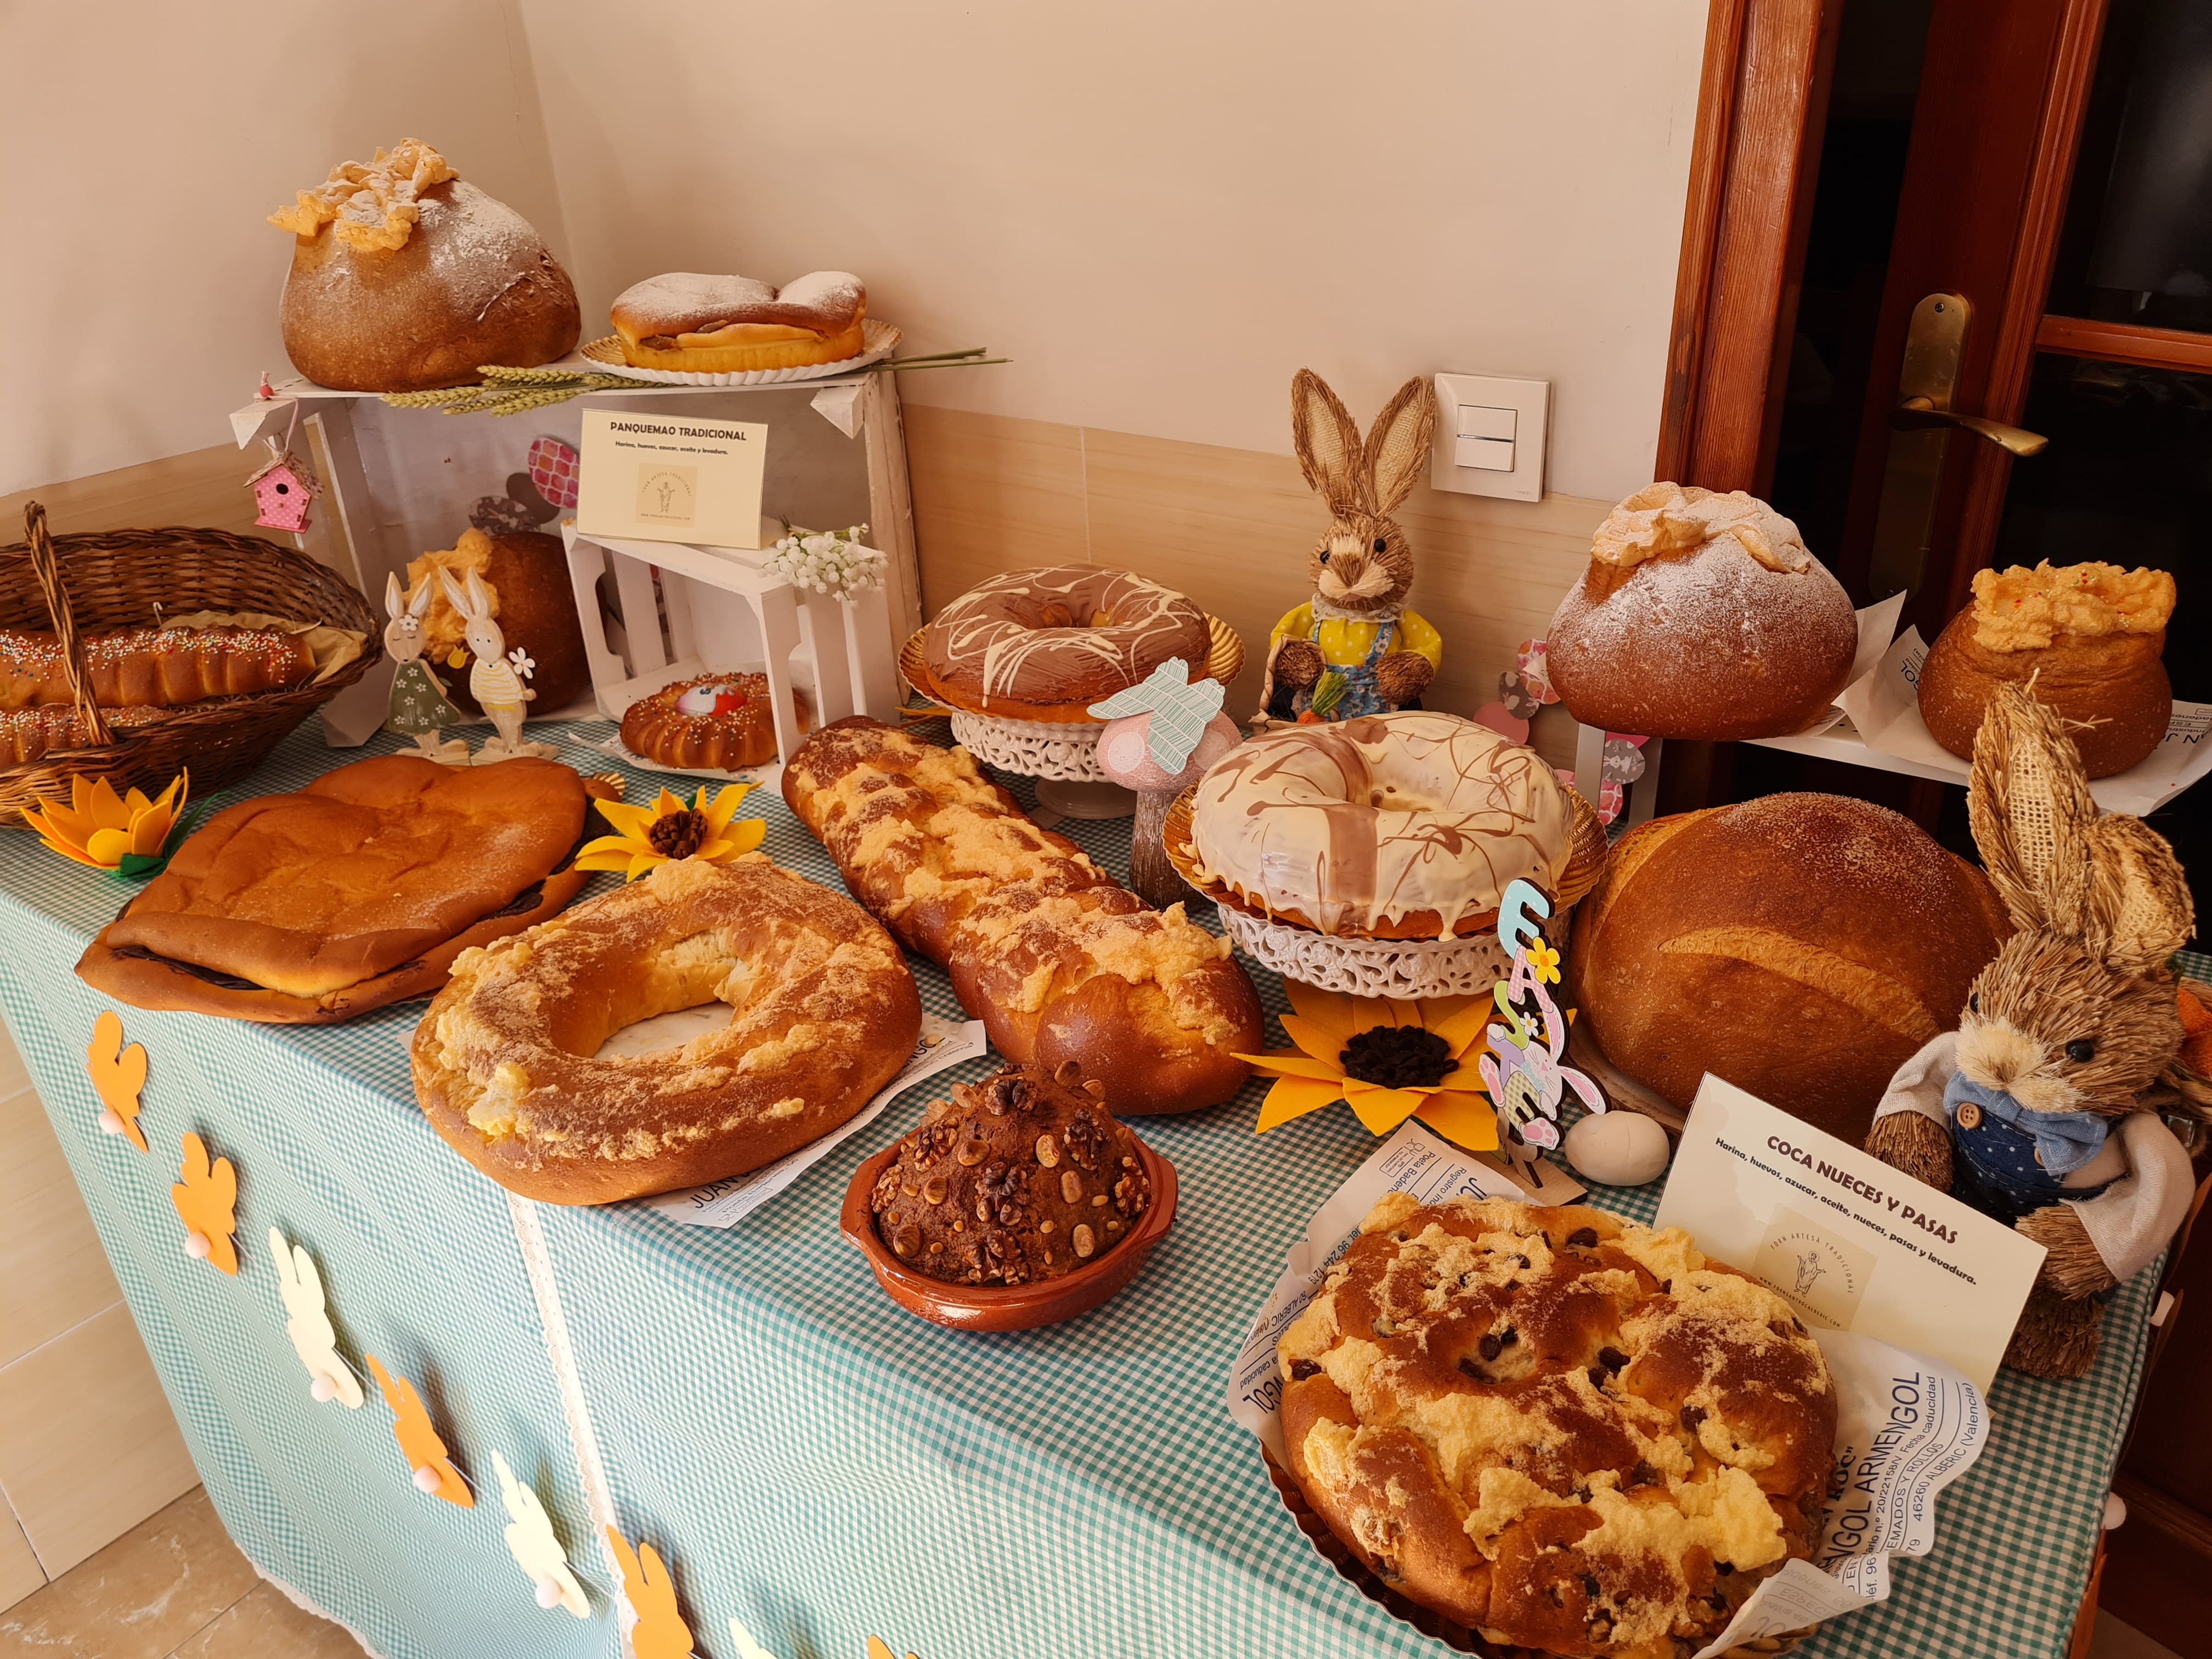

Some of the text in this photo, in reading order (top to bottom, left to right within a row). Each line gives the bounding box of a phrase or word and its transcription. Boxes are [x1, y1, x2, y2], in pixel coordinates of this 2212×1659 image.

[610, 422, 747, 441] PANQUEMAO TRADICIONAL
[1413, 1151, 1436, 1168] Poeta
[1440, 1167, 1467, 1194] Registro
[1767, 1136, 1958, 1244] COCA NUECES Y PASAS
[1716, 1137, 1977, 1285] Harina, huevos, azucar, aceite, nueces, pasas y levadura.
[1337, 1240, 1350, 1254] 96
[1770, 1236, 1787, 1250] FORN
[1825, 1242, 1854, 1294] TRADICIONAL
[1240, 1361, 1270, 1390] caducidad
[1854, 1372, 1920, 1493] ARMENGOL
[1900, 1434, 1926, 1453] Fecha
[1922, 1376, 1936, 1434] caducidad
[1866, 1557, 1877, 1575] 96
[1913, 1481, 1930, 1522] 46260
[1925, 1448, 1966, 1481] ALBERIC
[1960, 1383, 1978, 1447] (Valencia)
[1884, 1488, 1906, 1551] EMADOS
[1906, 1443, 1944, 1472] ROLLOS
